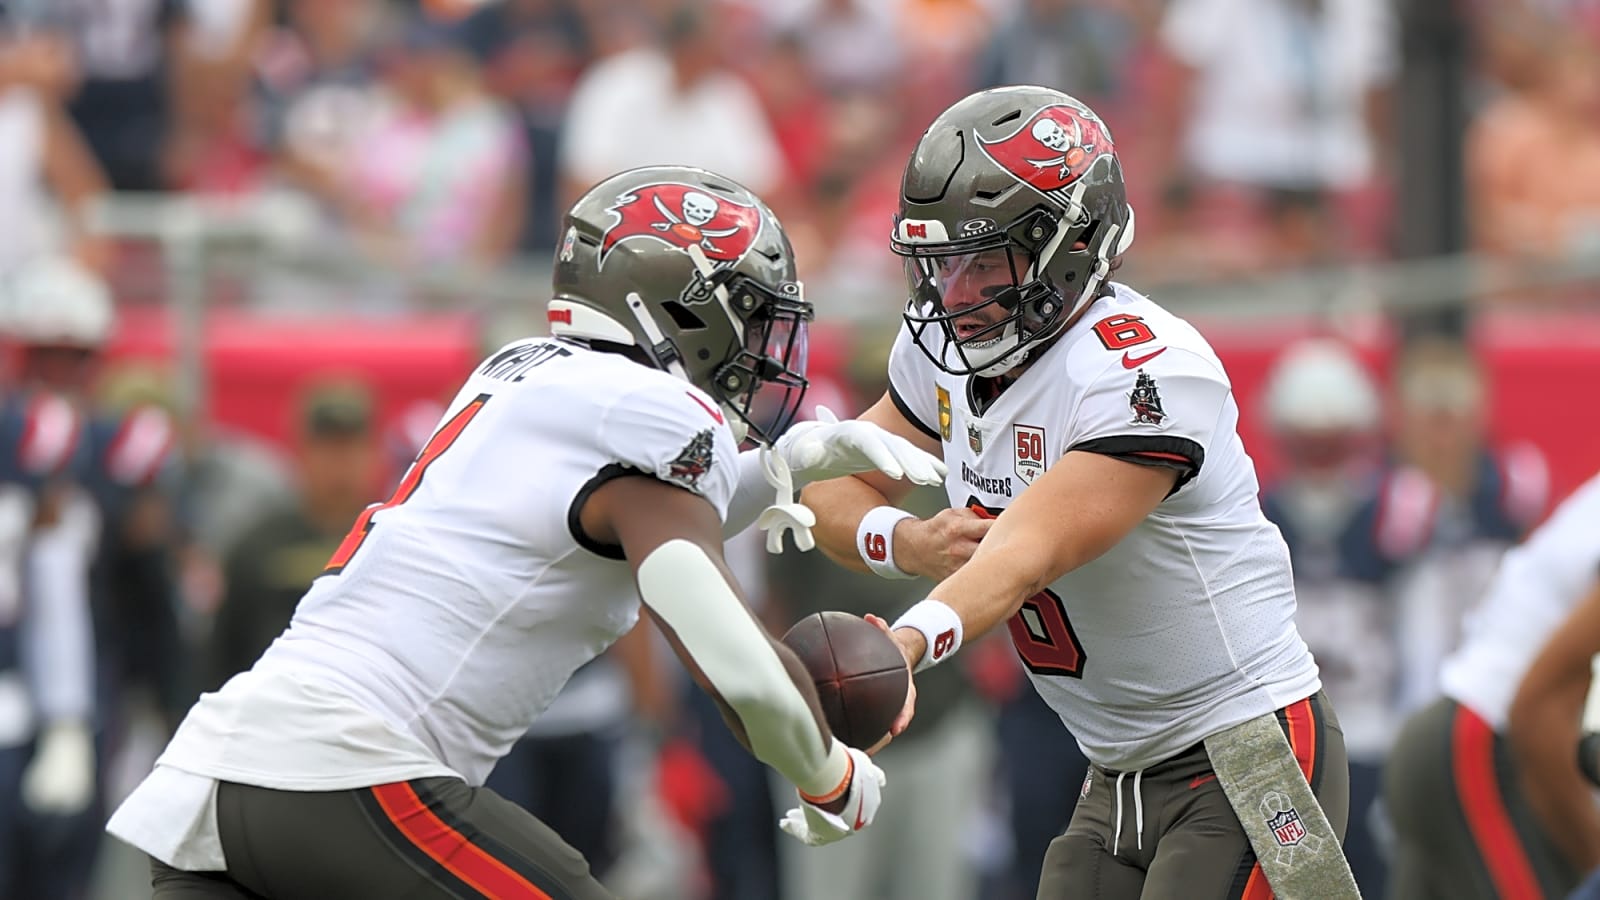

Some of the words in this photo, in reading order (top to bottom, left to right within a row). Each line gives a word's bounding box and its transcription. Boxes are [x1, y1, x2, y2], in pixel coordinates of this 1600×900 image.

[1090, 313, 1157, 351] 6
[1017, 431, 1042, 461] 50
[961, 461, 1013, 498] BUCCANEERS
[932, 628, 955, 660] 6
[1275, 822, 1304, 843] NFL
